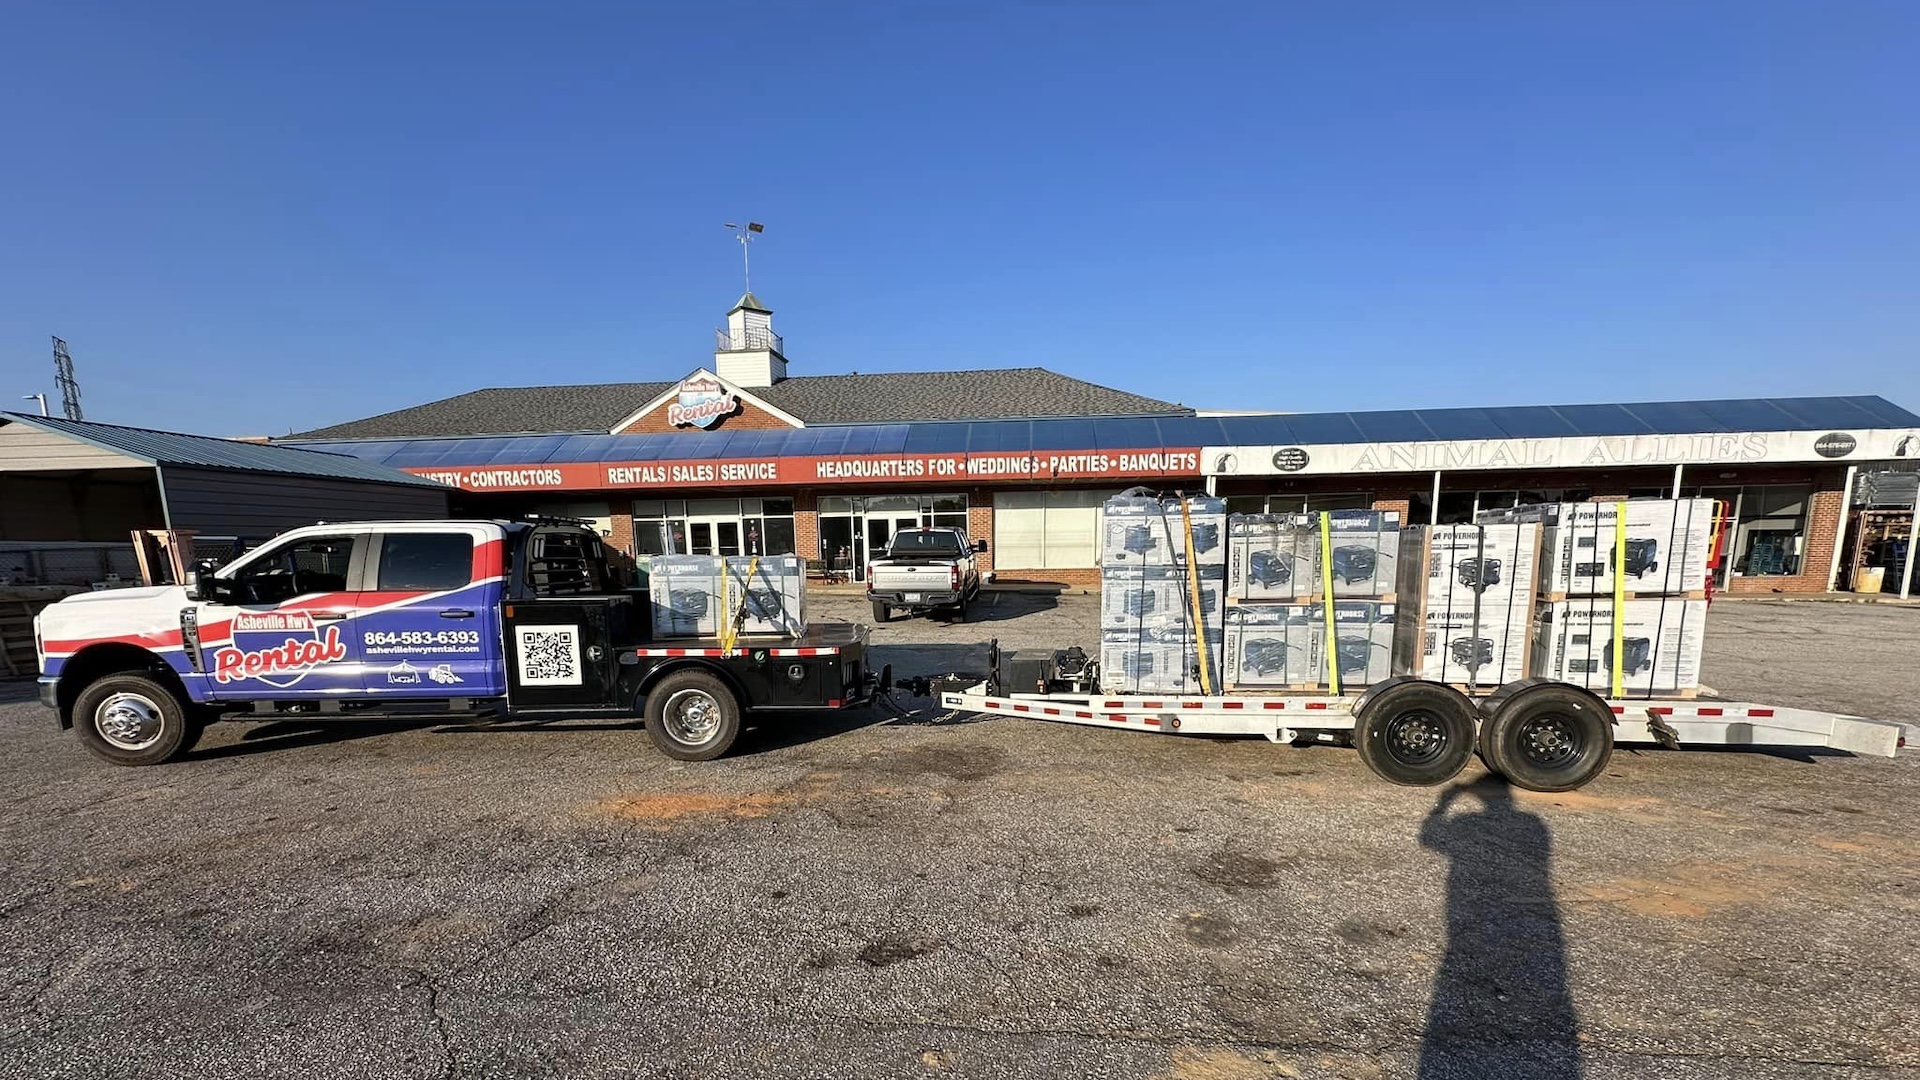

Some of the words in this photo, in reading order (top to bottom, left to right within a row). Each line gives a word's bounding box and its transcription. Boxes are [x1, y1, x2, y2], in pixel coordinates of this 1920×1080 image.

[669, 393, 736, 426] Rental
[1351, 439, 1552, 471] ANIMAL
[1582, 433, 1769, 465] ALLIES
[608, 466, 666, 483] RENTALS
[673, 465, 714, 482] SALES
[721, 463, 777, 480] SERVICE
[816, 460, 924, 478] HEADQUARTERS
[928, 459, 956, 475] FOR
[967, 457, 1041, 474] WEDDINGS
[1050, 455, 1109, 472] PARTIES
[1119, 453, 1196, 471] BANQUETS
[470, 469, 562, 487] CONTRACTORS
[237, 614, 285, 629] Asheville
[286, 614, 309, 629] Hwy
[364, 631, 480, 645] 864-583-6393
[215, 626, 346, 683] Rental
[366, 645, 480, 655] ashevillehwyrental.com
